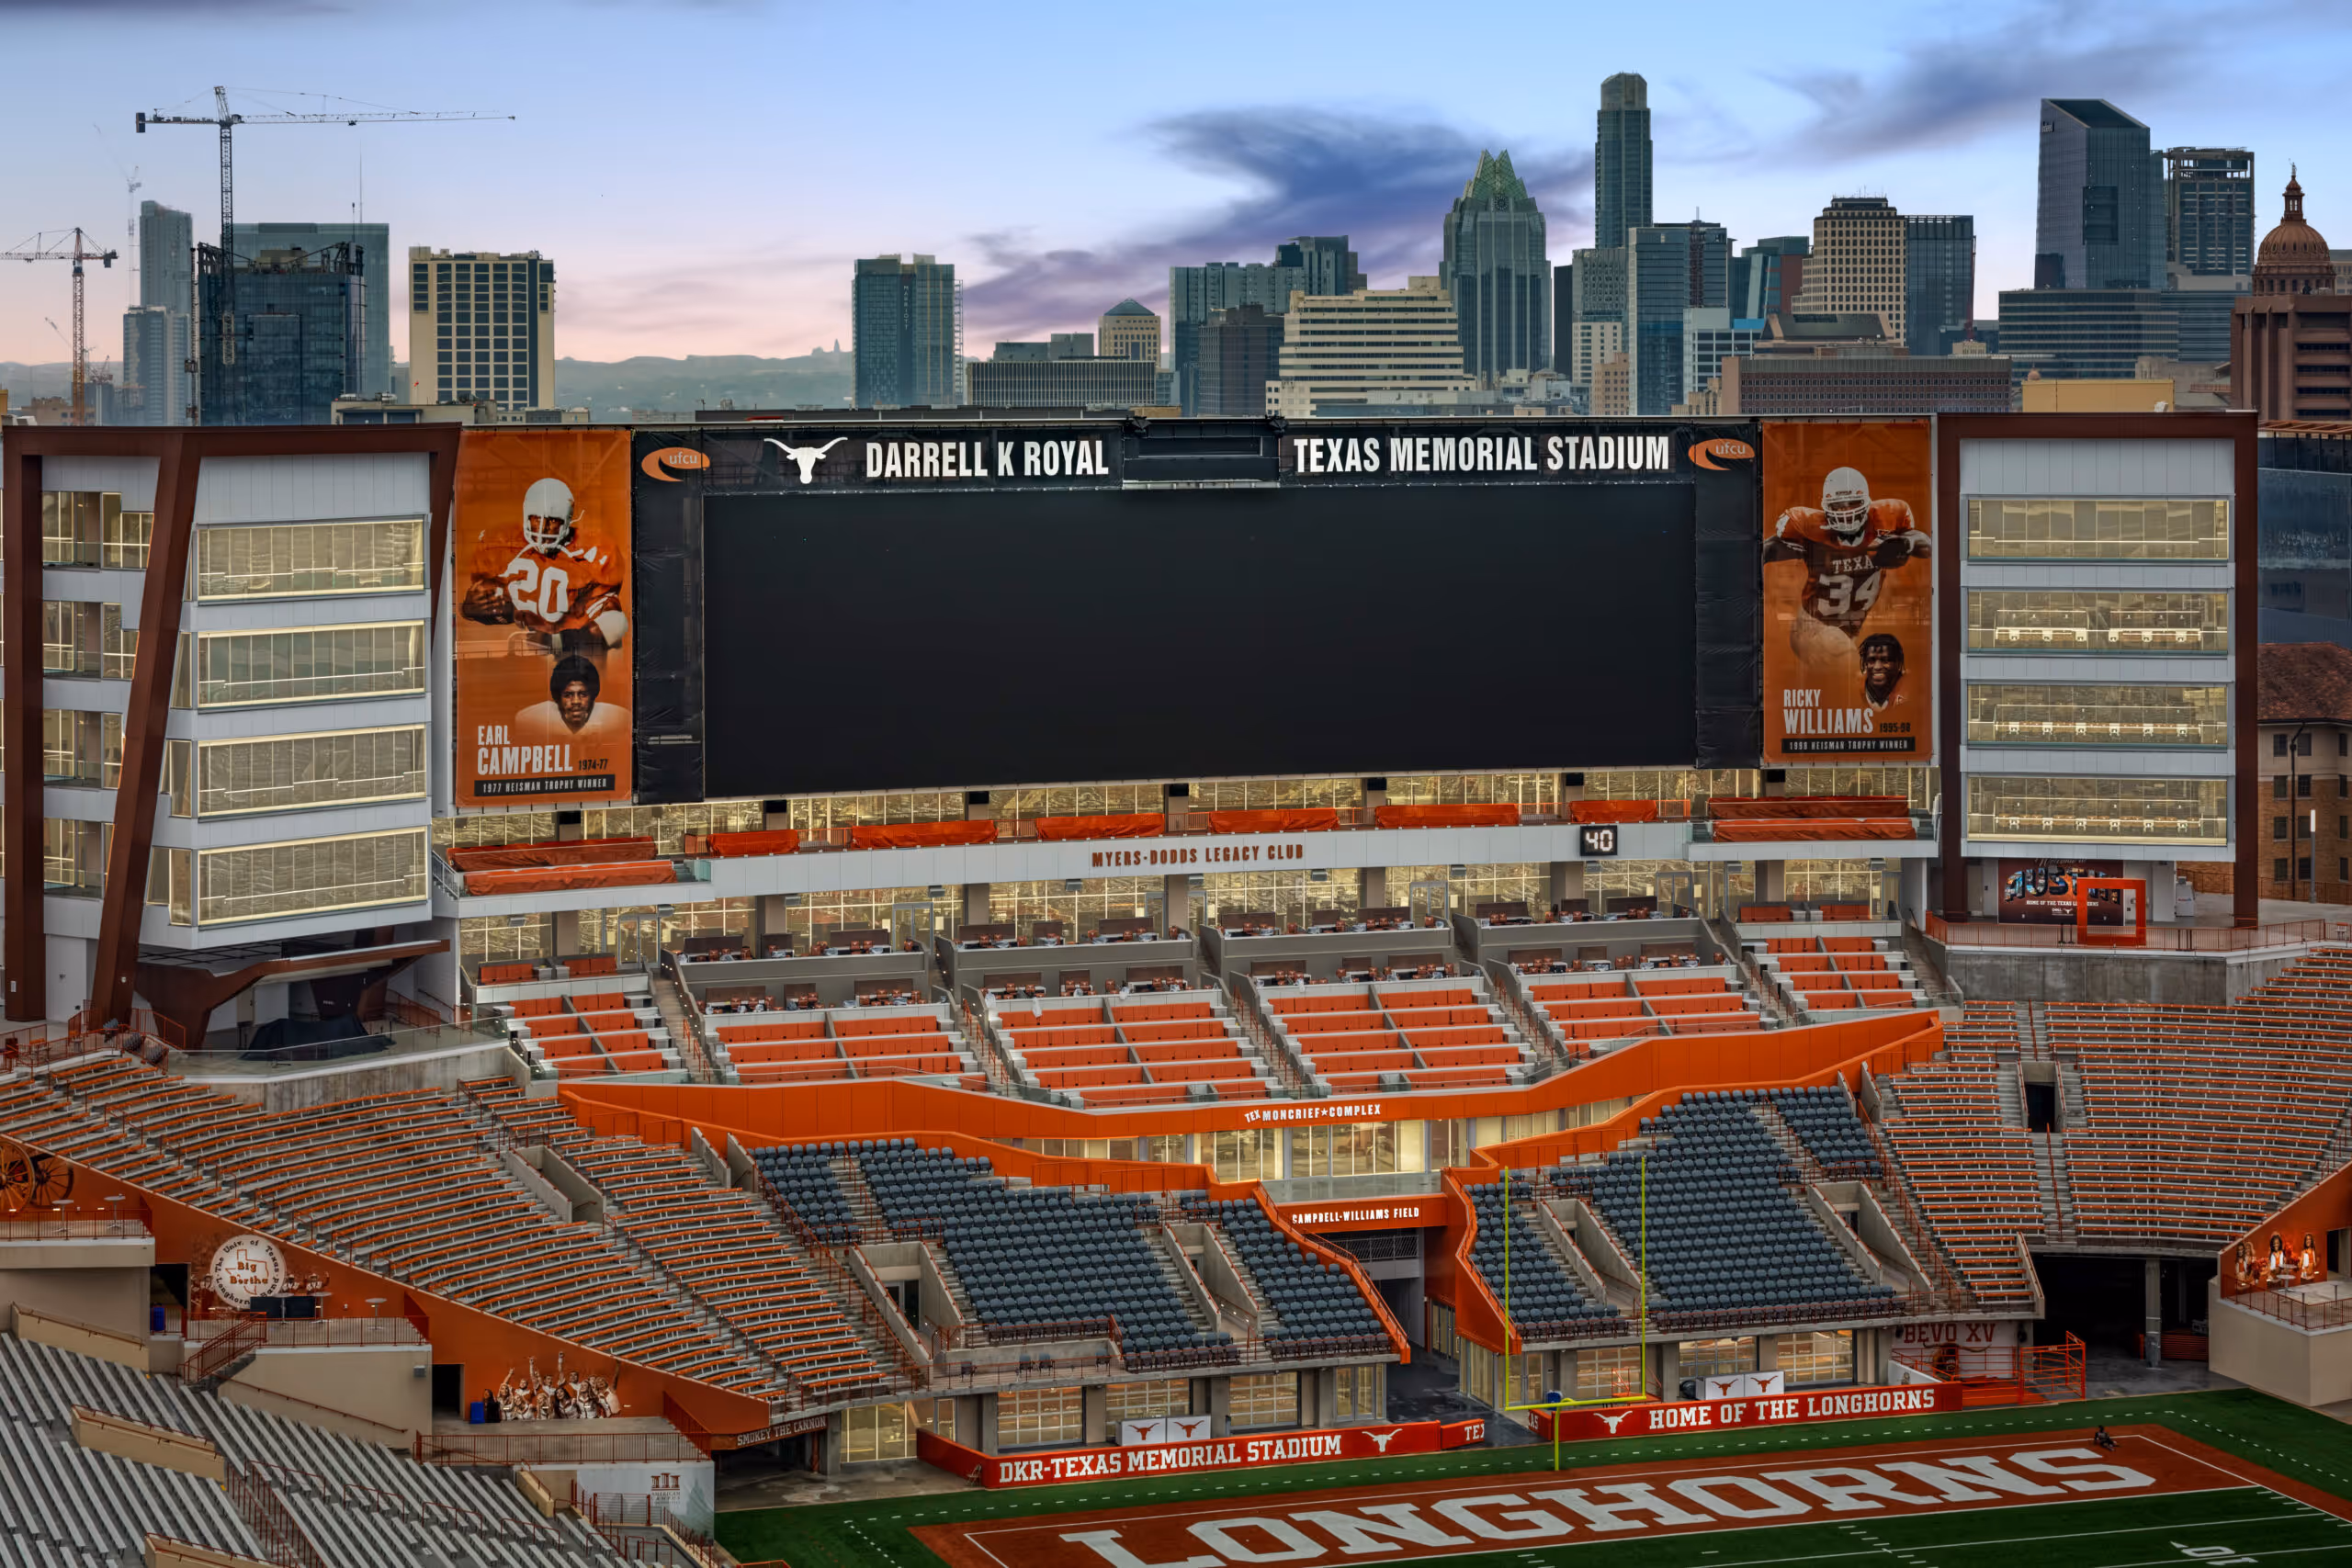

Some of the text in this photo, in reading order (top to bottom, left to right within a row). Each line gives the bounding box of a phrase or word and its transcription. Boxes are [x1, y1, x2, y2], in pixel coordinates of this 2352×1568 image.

[669, 451, 697, 466] ufcu
[865, 439, 1109, 478] DARRELL K ROYAL
[1294, 435, 1669, 473] TEXAS MEMORIAL STADIUM
[1715, 441, 1746, 456] ufcu
[1832, 555, 1879, 574] TEXA
[505, 558, 569, 623] 20
[1818, 570, 1882, 616] 34
[1783, 689, 1821, 707] RICKY
[1783, 708, 1873, 734] WILLIAMS
[478, 725, 510, 745] EARL
[1811, 740, 1845, 750] HEISMAN
[1848, 740, 1876, 750] TROPHY
[1880, 739, 1908, 750] WINNER
[477, 744, 573, 775] CAMPBELL
[578, 758, 608, 771] 1974-77
[483, 778, 606, 793] 1977 HEISMAN TROPHY WINNER
[1586, 829, 1612, 852] 40
[1205, 845, 1260, 863] LEGACY
[1268, 844, 1303, 860] CLUB
[1244, 1104, 1381, 1123] TEX MONCRIEF COMPLEX
[1393, 1207, 1419, 1219] FIELD
[215, 1257, 224, 1273] The
[223, 1240, 244, 1253] Univ.
[265, 1246, 279, 1273] Texas
[237, 1261, 257, 1272] Big
[230, 1275, 268, 1284] Bertha
[1904, 1323, 1996, 1344] BEVO XV
[1649, 1388, 1935, 1430] HOME OF THE LONGHORNS
[737, 1416, 827, 1446] SMOKEY THE CANNON
[999, 1434, 1342, 1483] DKR-TEXAS MEMORIAL STADIUM
[1058, 1448, 2156, 1568] LONGHORNS
